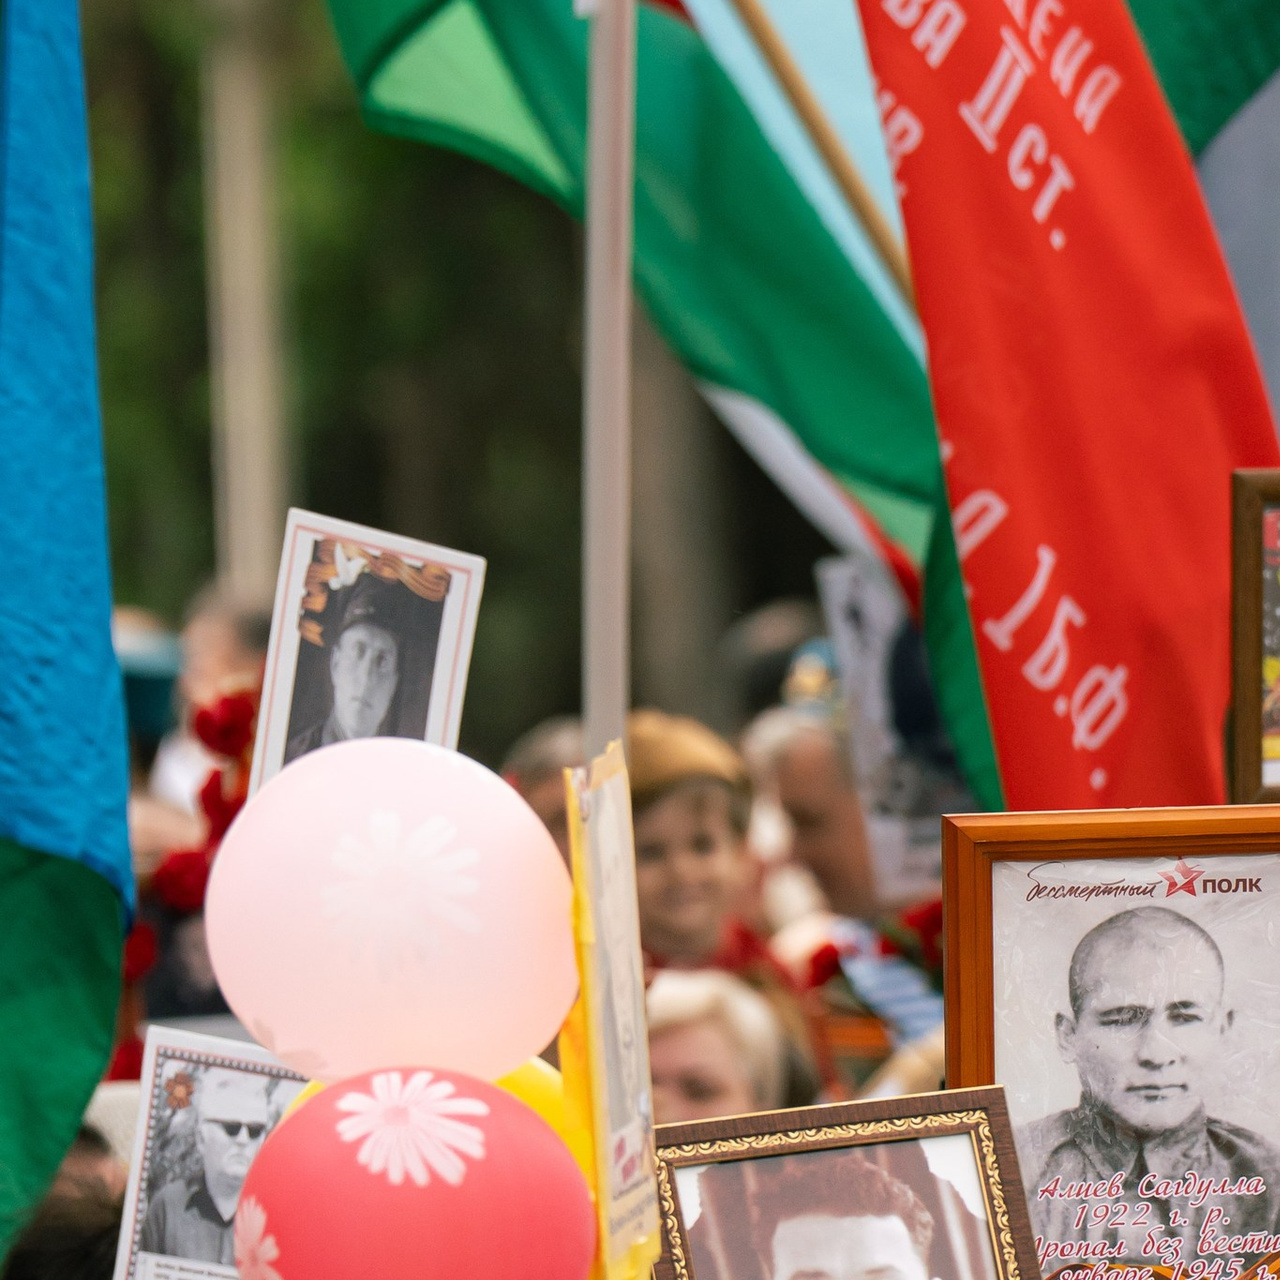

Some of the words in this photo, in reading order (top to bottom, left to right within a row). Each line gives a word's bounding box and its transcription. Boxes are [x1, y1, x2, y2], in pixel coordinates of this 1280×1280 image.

[1202, 877, 1263, 894] ПОЛК
[1038, 1171, 1124, 1200] Алиев
[1138, 1171, 1267, 1206] Сагдулла
[1074, 1203, 1152, 1229] 1922
[1169, 1208, 1189, 1226] г.
[1201, 1206, 1231, 1235] р.
[1141, 1225, 1185, 1266] без
